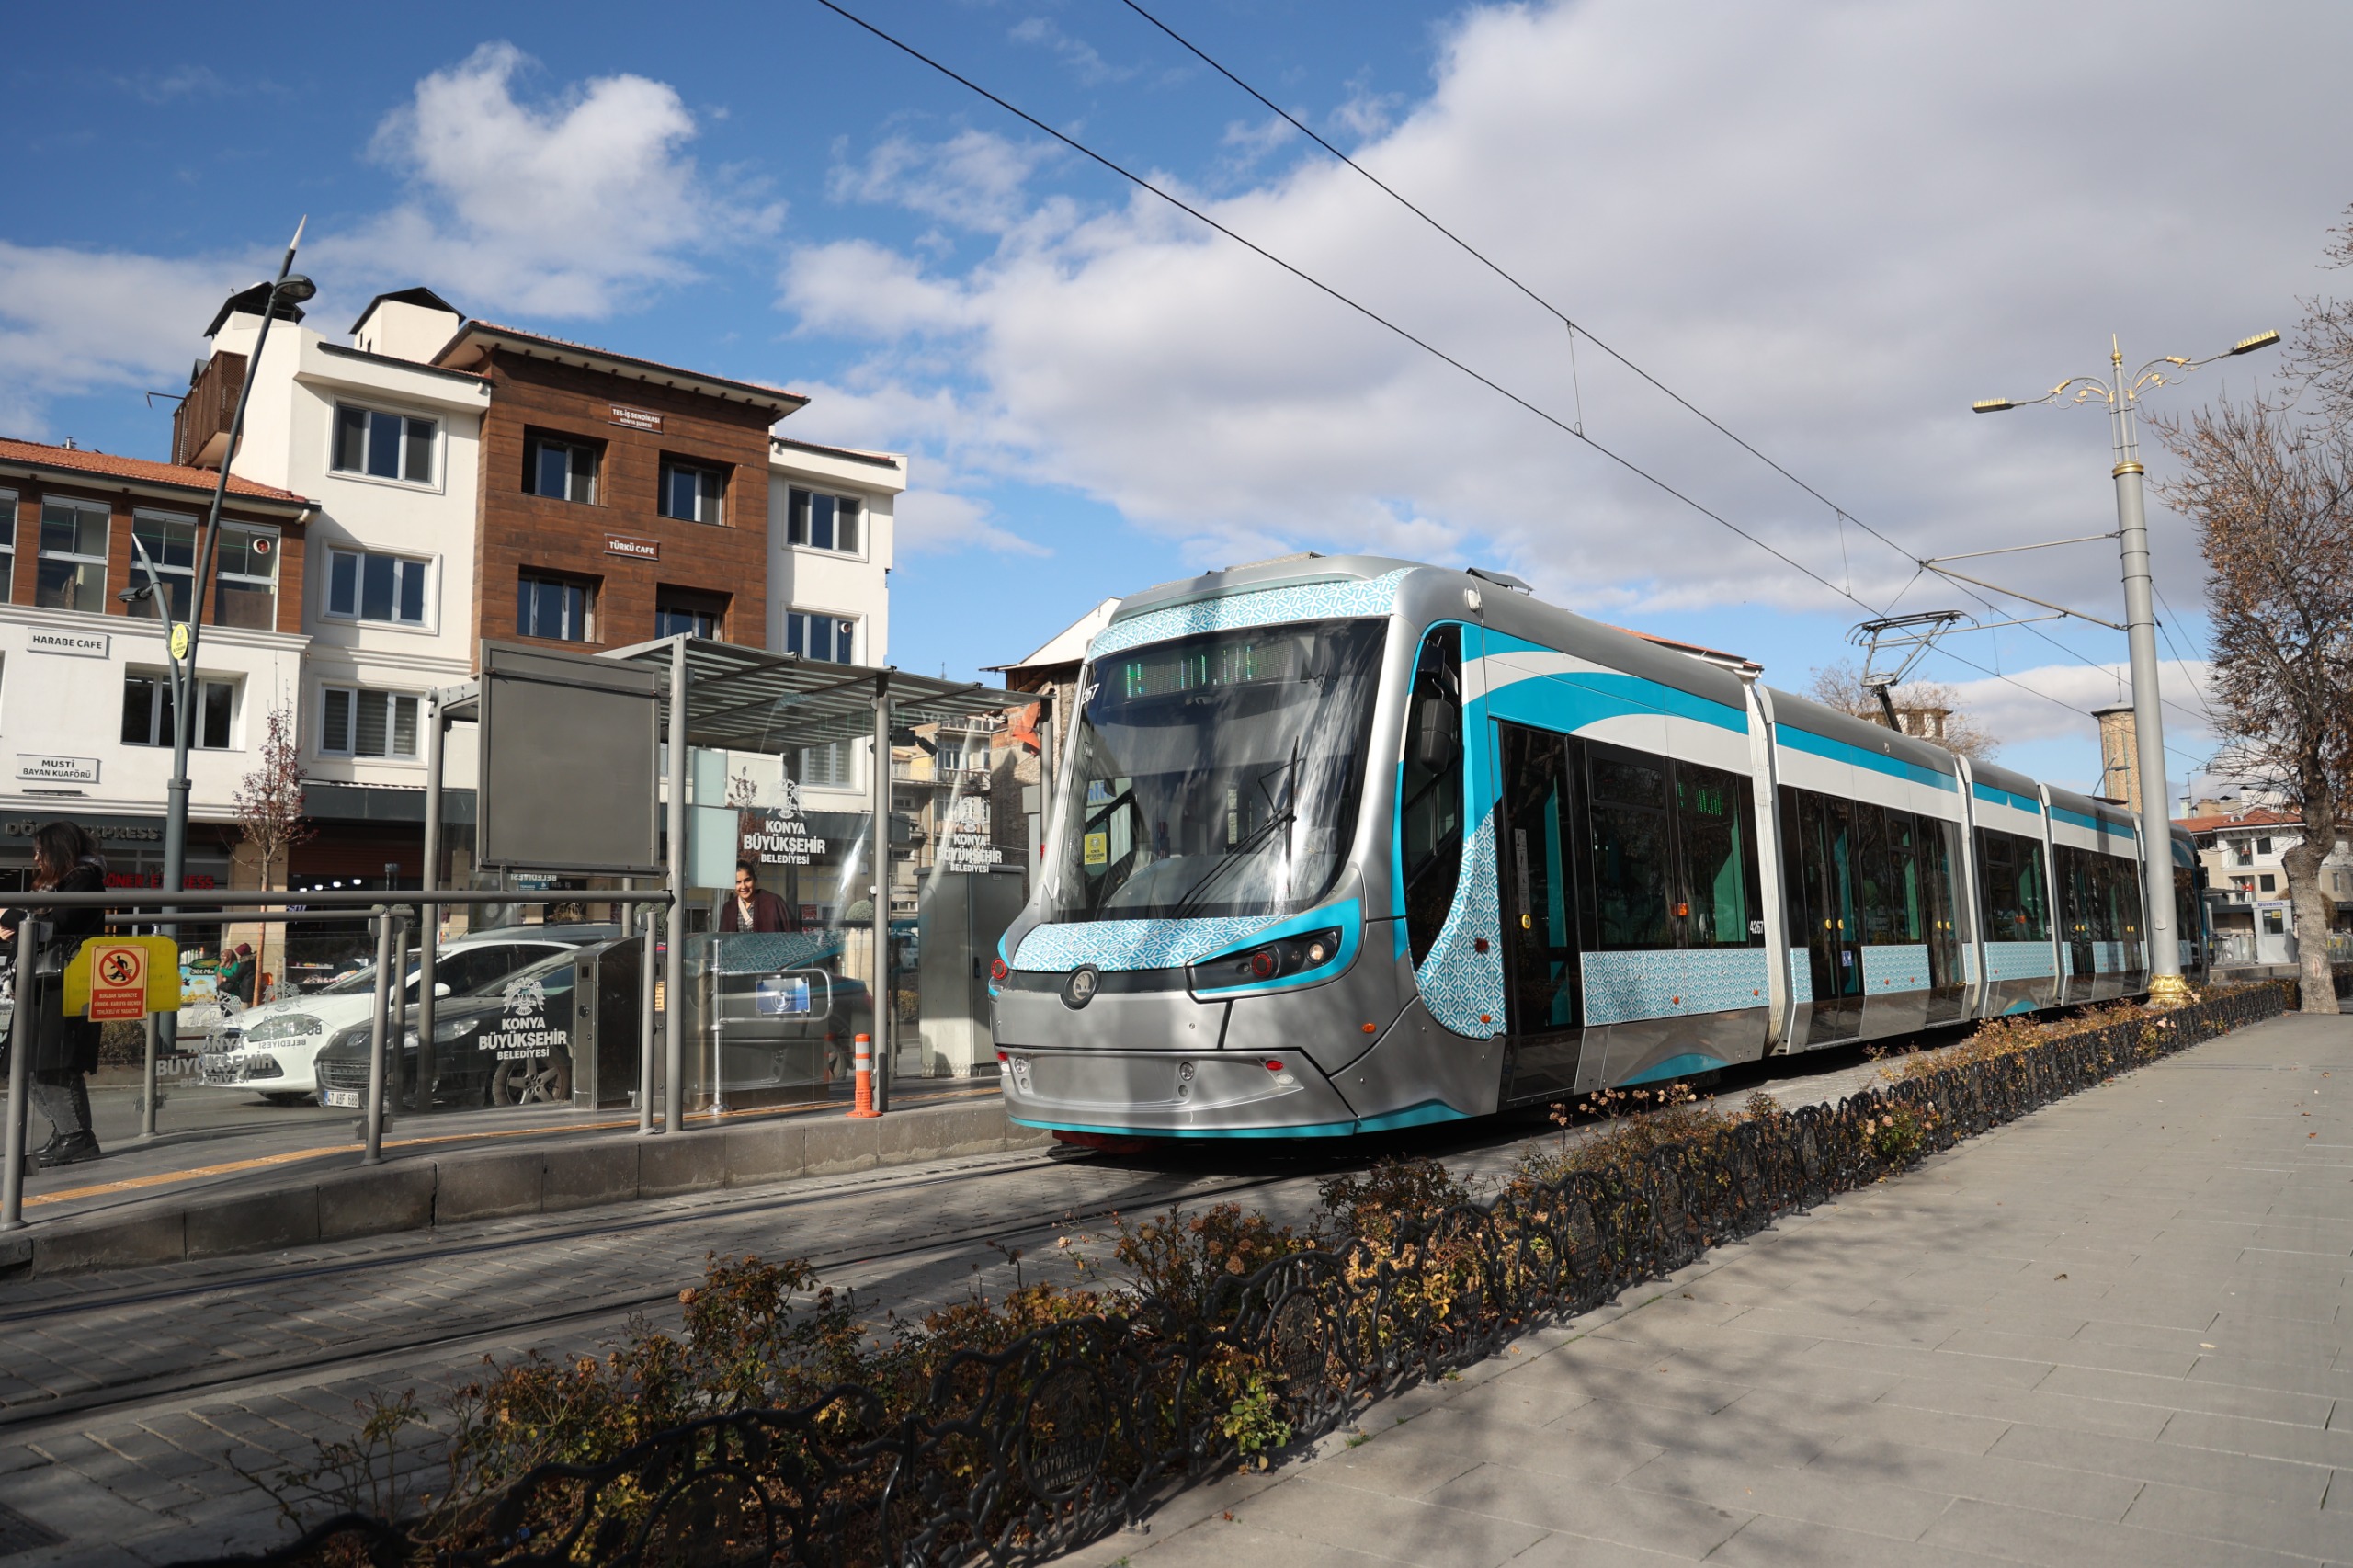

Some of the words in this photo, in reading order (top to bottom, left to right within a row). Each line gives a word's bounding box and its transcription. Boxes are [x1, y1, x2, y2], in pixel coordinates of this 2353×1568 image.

[631, 413, 661, 424] SENDİKASI
[609, 540, 634, 551] TÜRKÜ
[635, 545, 654, 555] CAFE
[32, 635, 74, 647] HARABE
[76, 640, 102, 649] CAFE
[41, 759, 75, 768] MUSTİ
[23, 768, 51, 777] BAYAN
[52, 769, 91, 778] KUAFÖRÜ
[765, 820, 806, 835] KONYA
[744, 832, 825, 854] BÜYÜKŞEHİR
[953, 834, 986, 846] KONYA
[761, 853, 809, 864] BELEDİYESİ
[937, 846, 1002, 864] BÜYÜKŞEHİR
[949, 863, 989, 873] BELEDİYESİ
[1750, 920, 1763, 935] 4267
[502, 1017, 546, 1030] KONYA
[187, 1037, 245, 1053] KONYA
[478, 1028, 567, 1050] BÜYÜKŞEHİR
[496, 1046, 550, 1060] BELEDİYESİ
[155, 1050, 274, 1076] BÜYÜKŞEHİR
